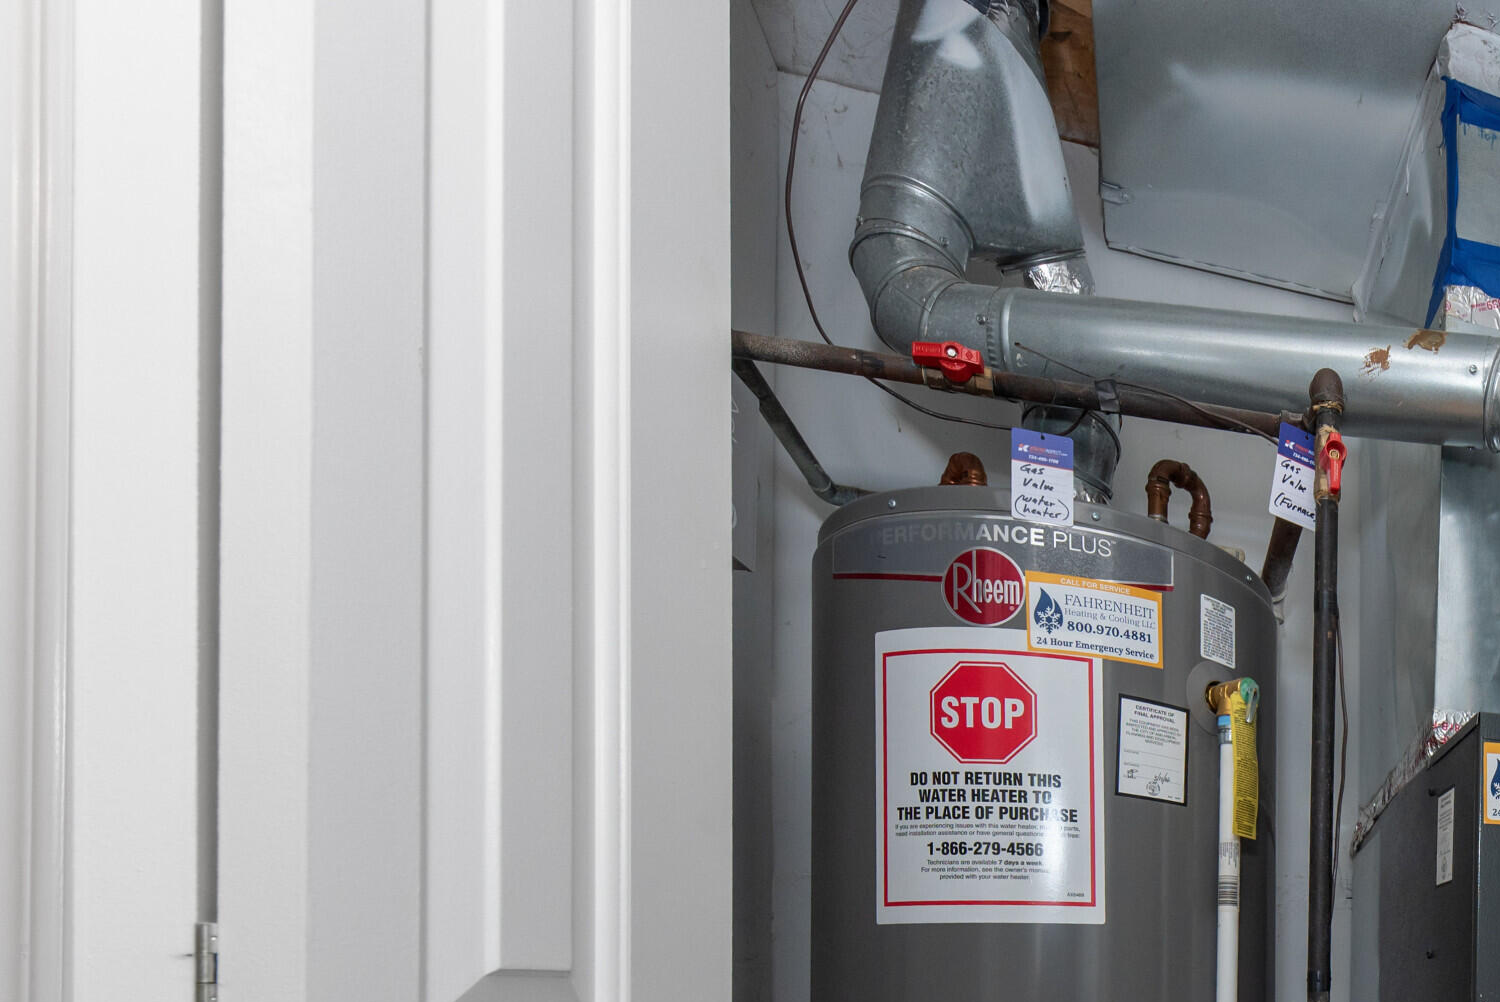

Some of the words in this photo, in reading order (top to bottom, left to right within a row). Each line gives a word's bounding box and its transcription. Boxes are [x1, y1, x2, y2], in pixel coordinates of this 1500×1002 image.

[1053, 531, 1112, 557] PLUS
[952, 550, 1021, 614] Rheem
[1060, 578, 1080, 586] CALL
[1082, 580, 1098, 589] FOR
[1099, 584, 1131, 594] SERVICE
[1064, 607, 1098, 620] Heating
[1108, 613, 1140, 628] Cooling
[1141, 619, 1156, 629] LLC
[1065, 594, 1154, 619] FAHRENHEIT
[1067, 620, 1152, 644] 800.970.4881
[1036, 636, 1048, 645] 24
[1050, 637, 1074, 648] Hour
[1075, 640, 1124, 656] Emergency
[1125, 647, 1155, 660] Service
[940, 695, 1025, 729] STOP
[910, 771, 928, 786] DO
[932, 771, 960, 786] NOT
[964, 771, 1023, 787] RETURN
[1028, 773, 1062, 788] THIS
[919, 788, 966, 803] WATER
[971, 788, 1028, 804] HEATER
[1032, 790, 1052, 805] TO
[897, 806, 921, 821] THE
[925, 806, 971, 820] PLACE
[975, 806, 994, 820] OF
[927, 841, 1044, 856] 1-866-279-4566
